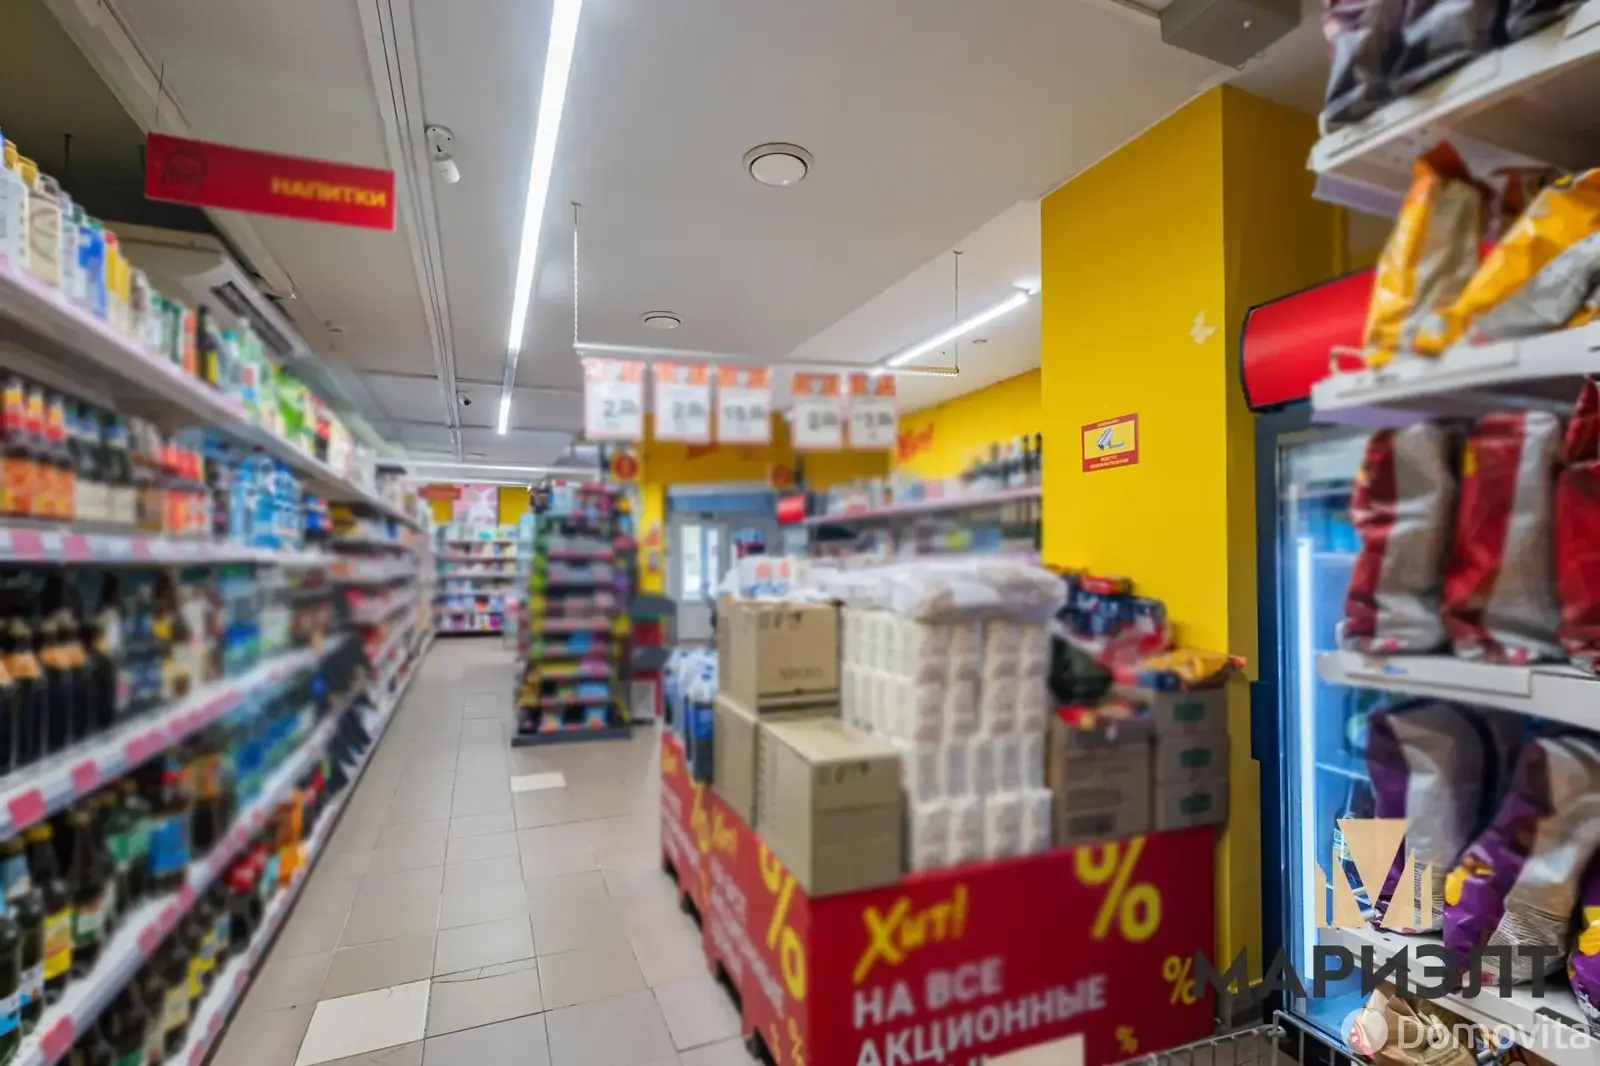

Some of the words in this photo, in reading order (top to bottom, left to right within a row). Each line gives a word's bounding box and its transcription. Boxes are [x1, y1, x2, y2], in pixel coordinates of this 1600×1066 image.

[270, 177, 386, 208] НАПИТКИ
[853, 882, 968, 985] Хит!
[853, 980, 915, 1030] НА
[924, 956, 1003, 1011] ВСЕ
[855, 974, 1107, 1066] АКЦИОННЫЕ
